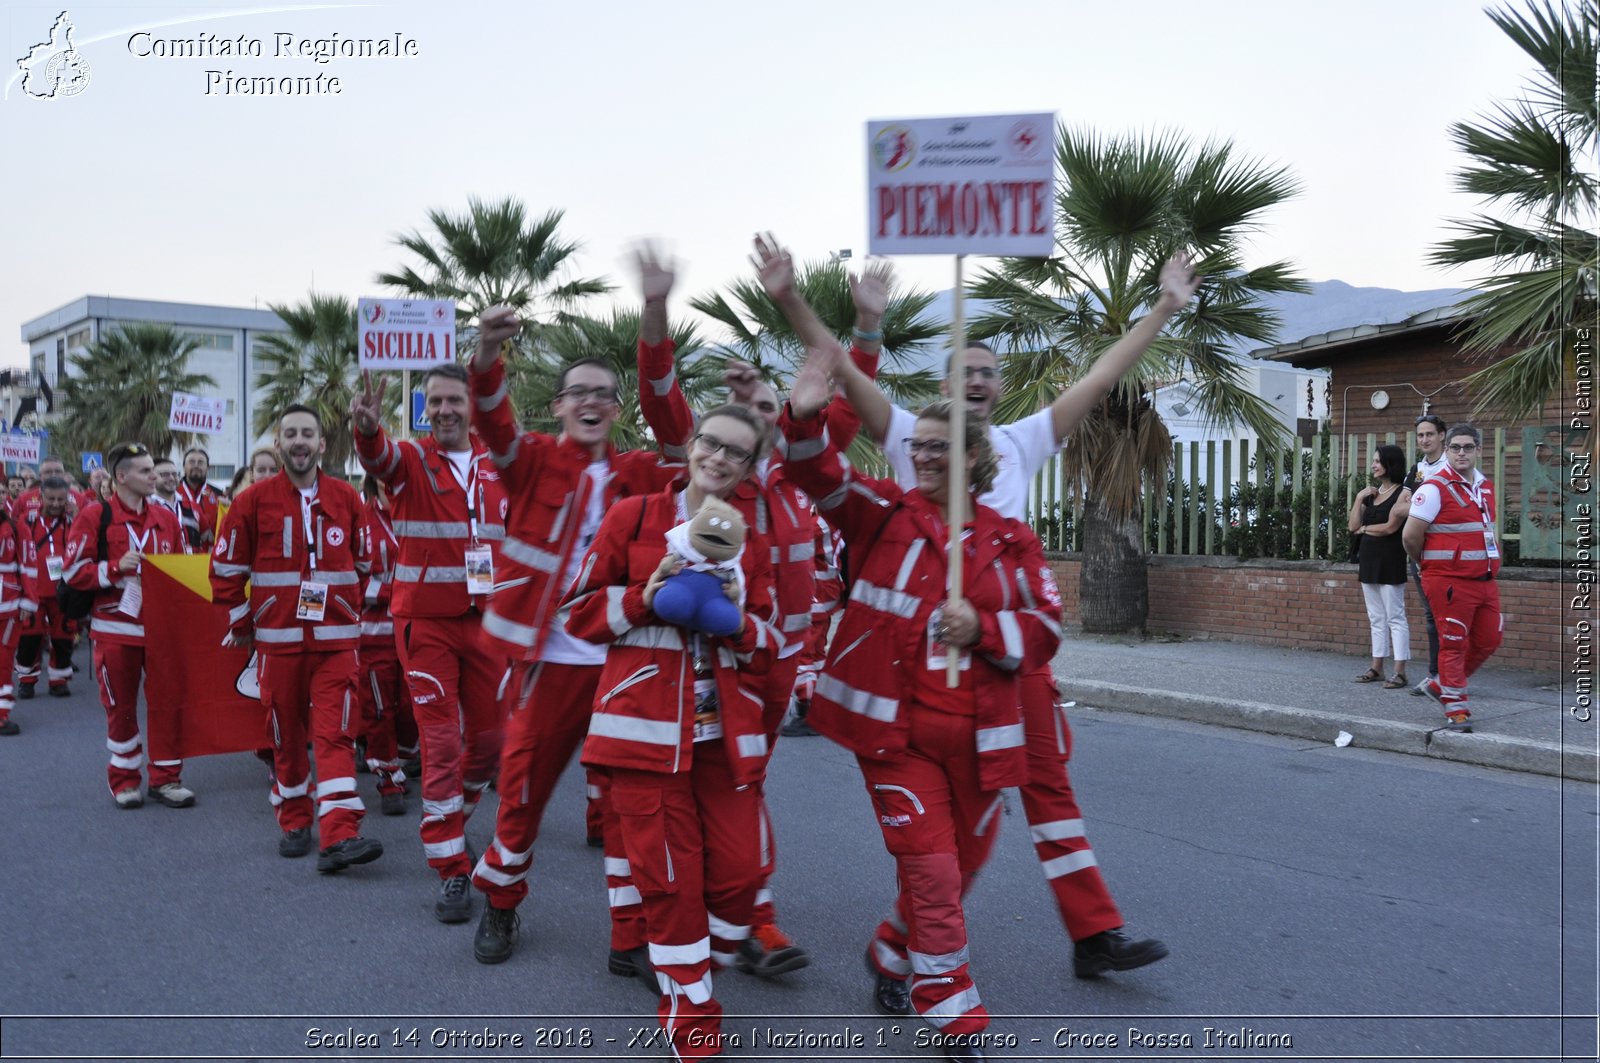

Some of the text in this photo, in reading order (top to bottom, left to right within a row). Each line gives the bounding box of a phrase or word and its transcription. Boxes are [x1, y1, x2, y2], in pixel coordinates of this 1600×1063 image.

[876, 180, 1047, 238] PIEMONTE
[364, 331, 451, 360] SICILIA 1
[173, 411, 222, 431] SICILIA 2
[2, 447, 37, 460] TOSCANA
